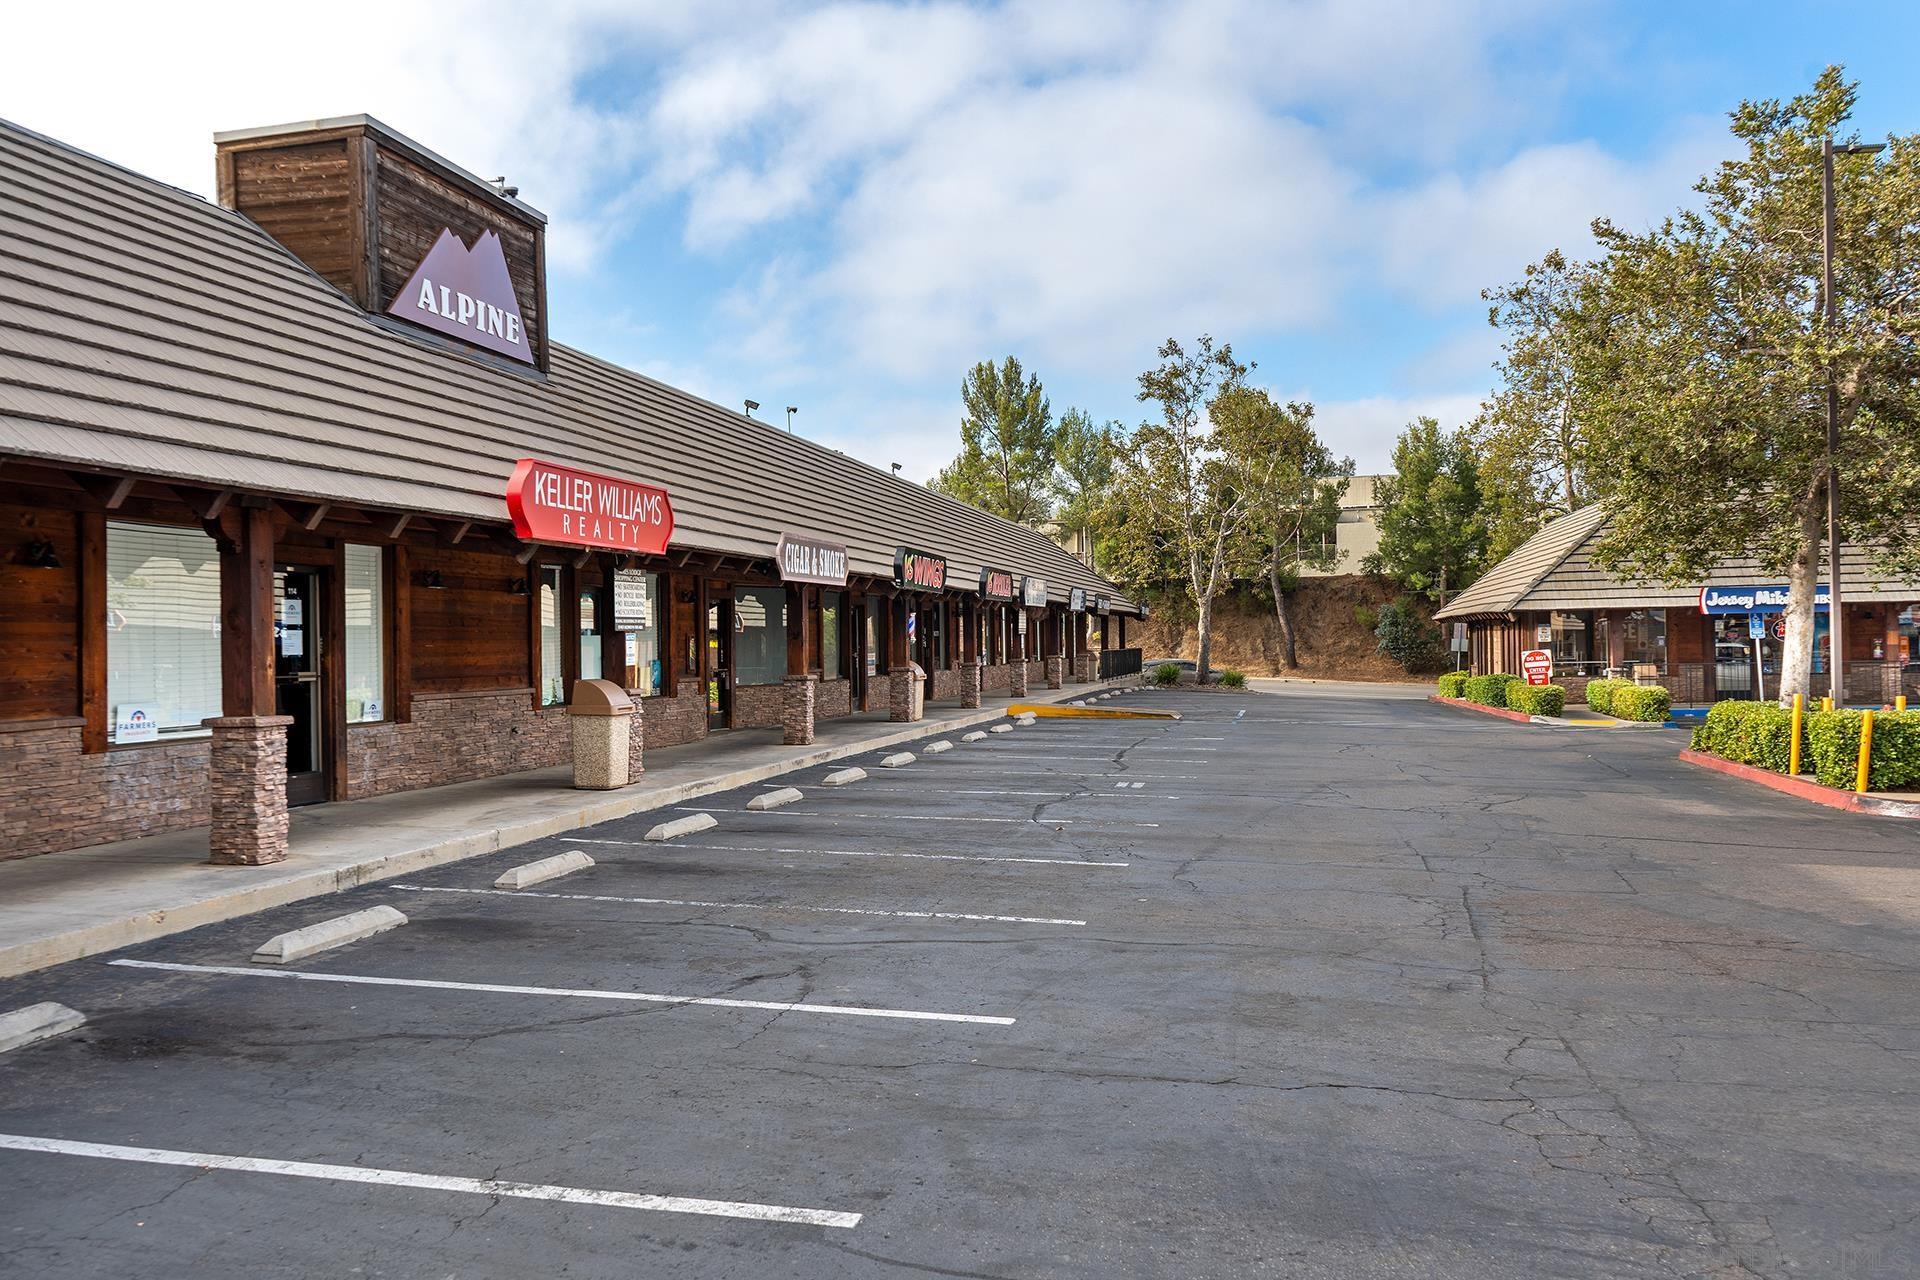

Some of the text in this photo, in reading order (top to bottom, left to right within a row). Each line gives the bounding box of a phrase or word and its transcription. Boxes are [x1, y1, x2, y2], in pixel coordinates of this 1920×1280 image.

[417, 278, 520, 345] ALPINE
[535, 470, 662, 526] KELLER WILLIAMS
[563, 513, 640, 544] REALTY
[785, 543, 845, 579] CIGAR & SMOKE
[914, 554, 944, 588] WINGS
[1706, 592, 1754, 609] Jersey
[119, 721, 157, 730] FARMERS
